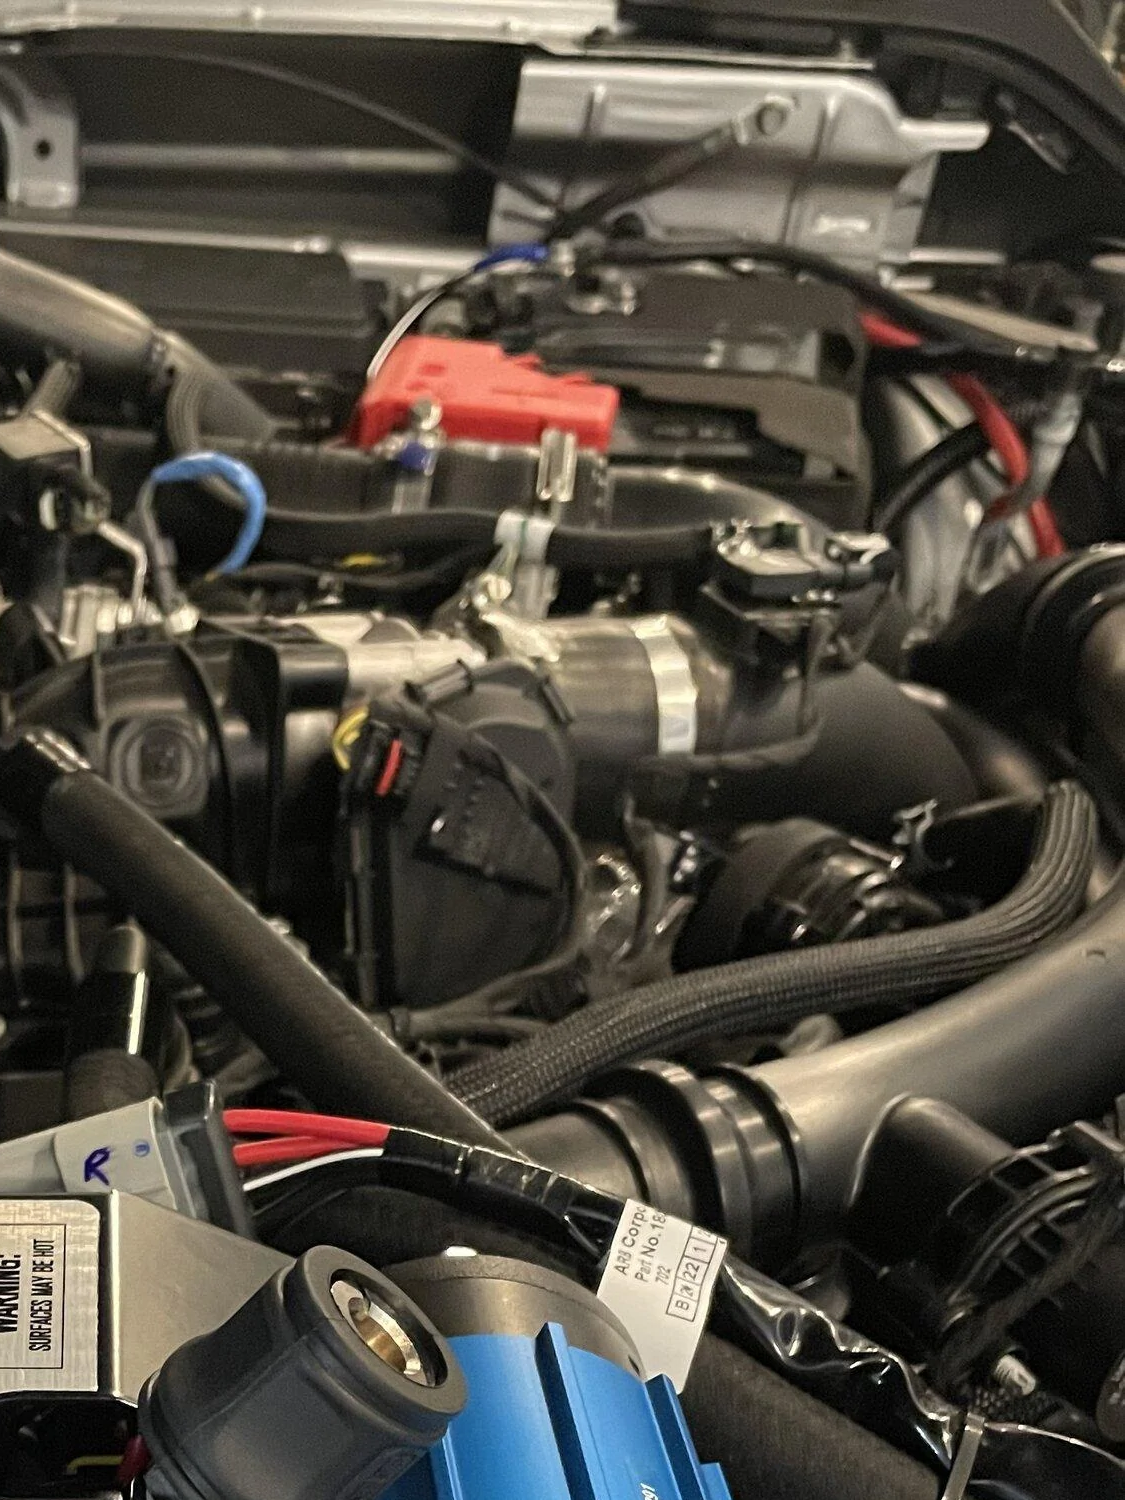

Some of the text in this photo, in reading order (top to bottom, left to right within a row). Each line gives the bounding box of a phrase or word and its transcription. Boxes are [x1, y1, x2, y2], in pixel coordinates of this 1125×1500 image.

[84, 1147, 110, 1186] R
[28, 1239, 55, 1352] SURFACES MAY BE HOT
